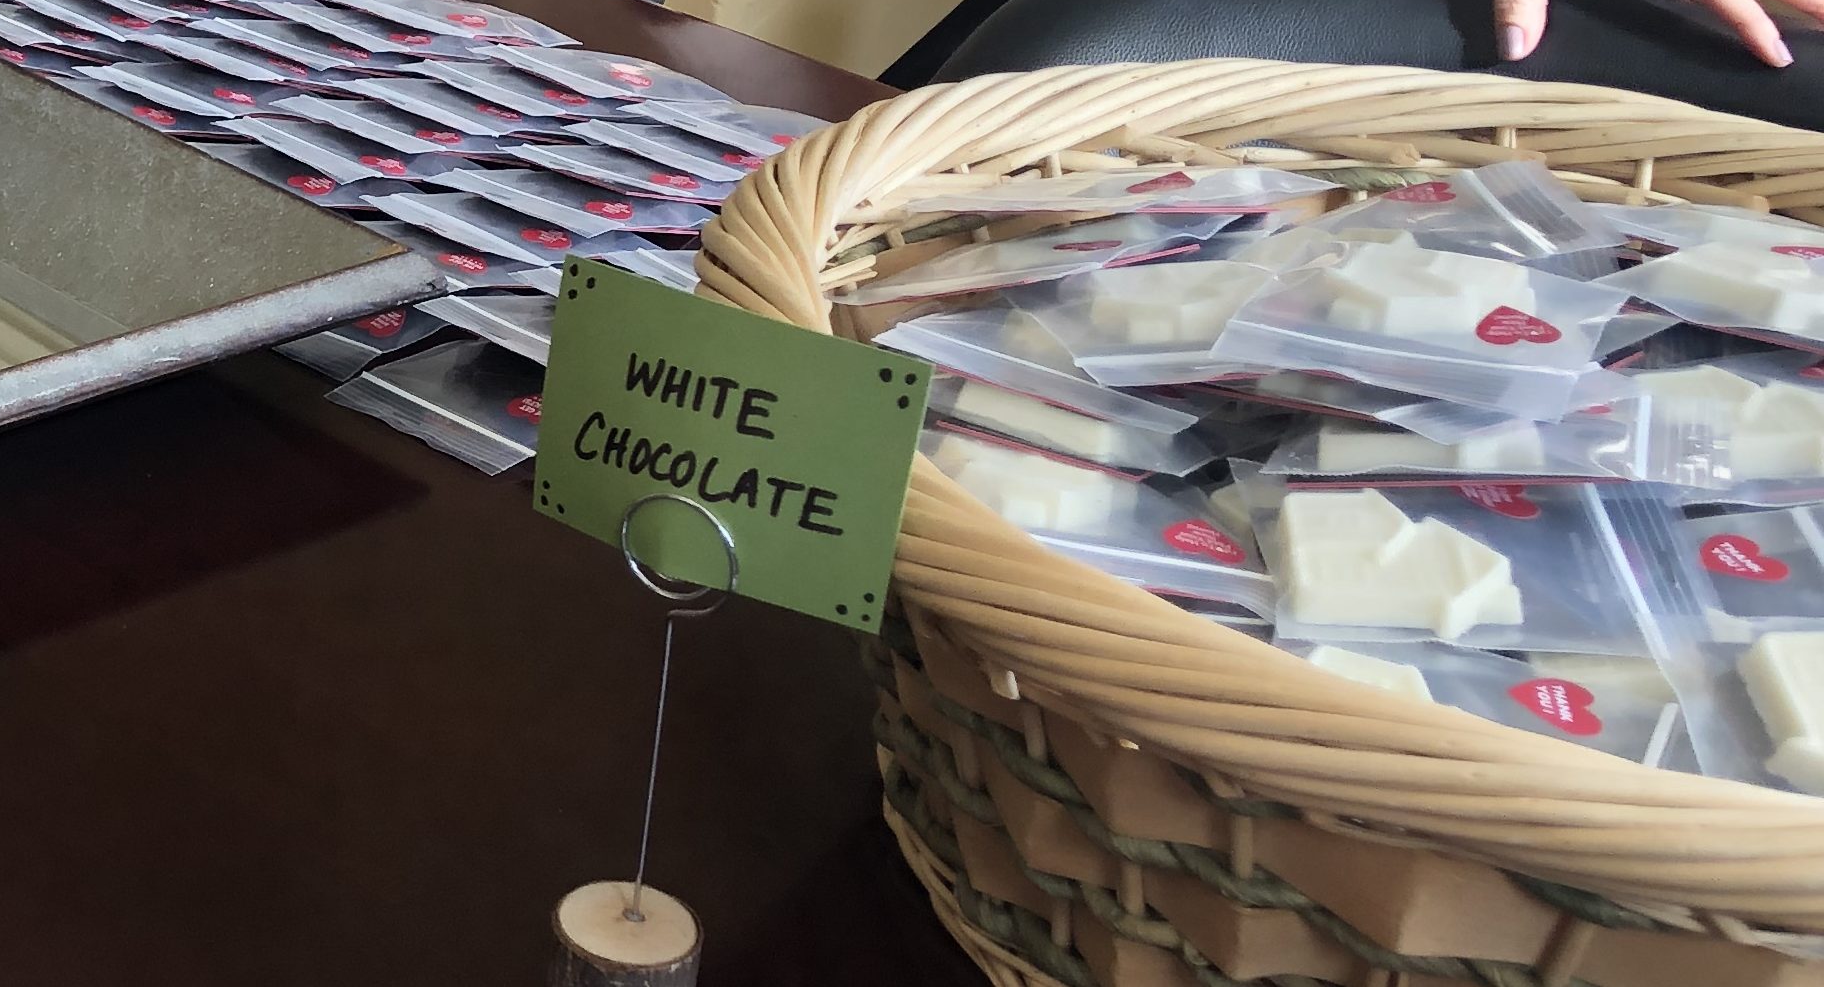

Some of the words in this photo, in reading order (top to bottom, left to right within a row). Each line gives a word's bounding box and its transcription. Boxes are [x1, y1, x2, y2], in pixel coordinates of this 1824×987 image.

[624, 352, 779, 440] WHITE
[574, 411, 844, 536] CHOCOLATE
[1718, 541, 1766, 573] THANK
[1535, 685, 1556, 715] YOU!
[1551, 684, 1575, 723] THANK
